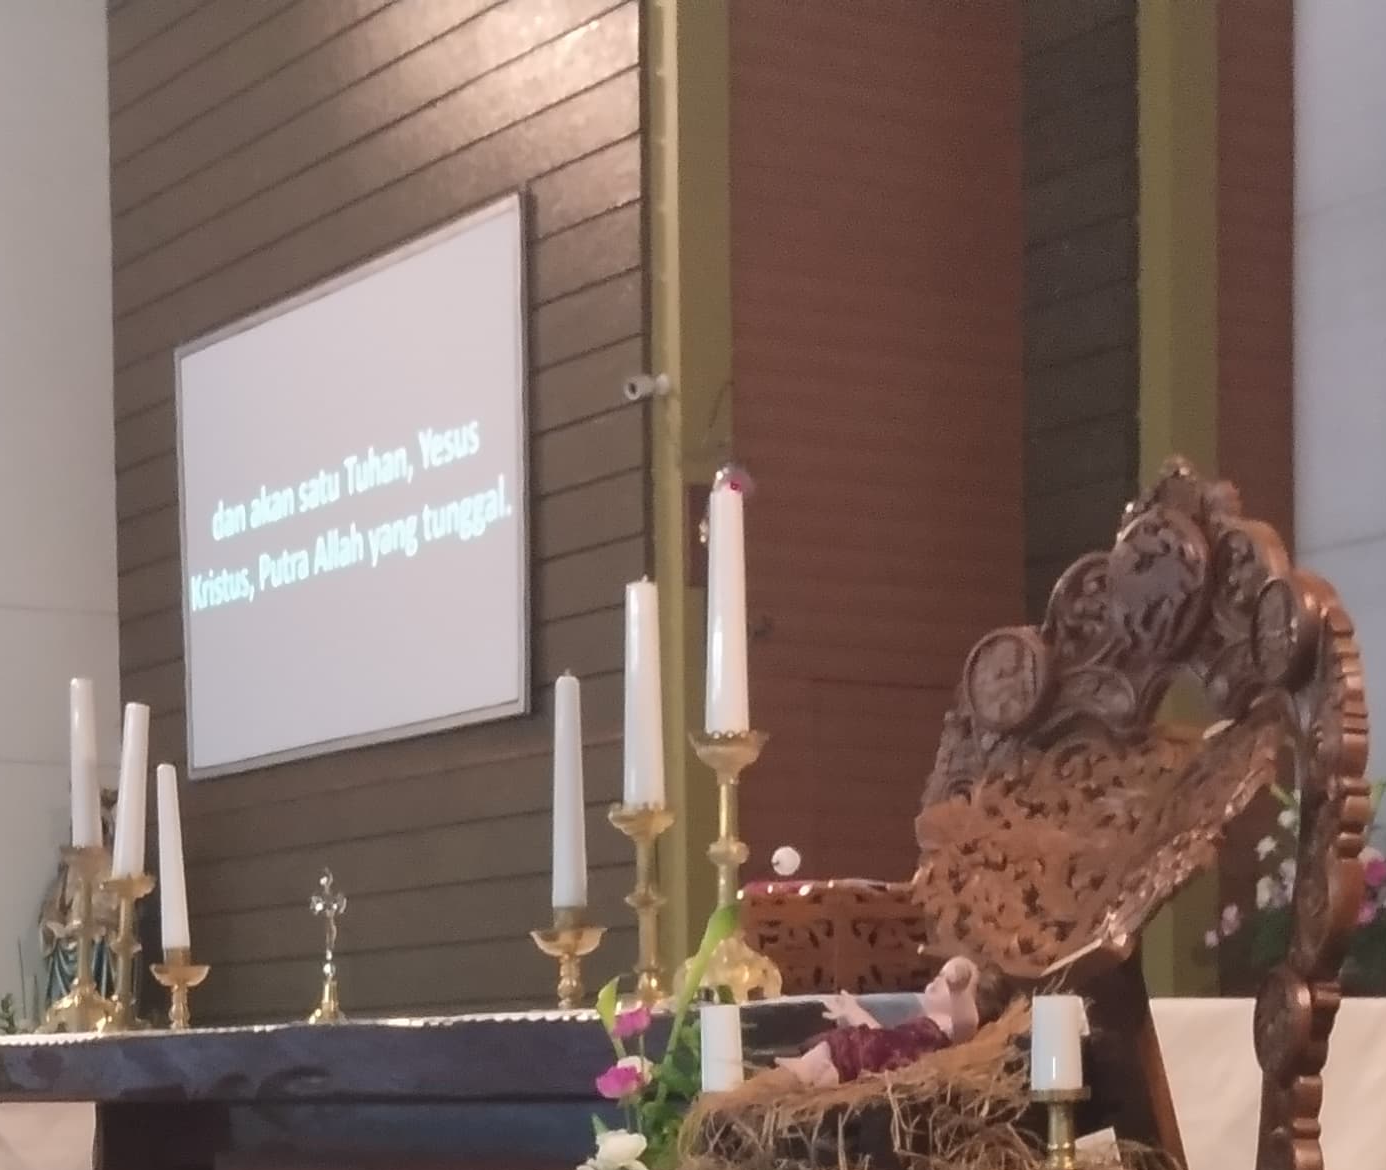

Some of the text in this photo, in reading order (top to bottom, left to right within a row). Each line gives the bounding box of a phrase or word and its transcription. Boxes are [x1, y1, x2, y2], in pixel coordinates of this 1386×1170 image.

[191, 474, 512, 611] Kristus, Putra Allah yang tunggal.
[212, 421, 479, 540] dan akan satu Tuhan, Yesus
